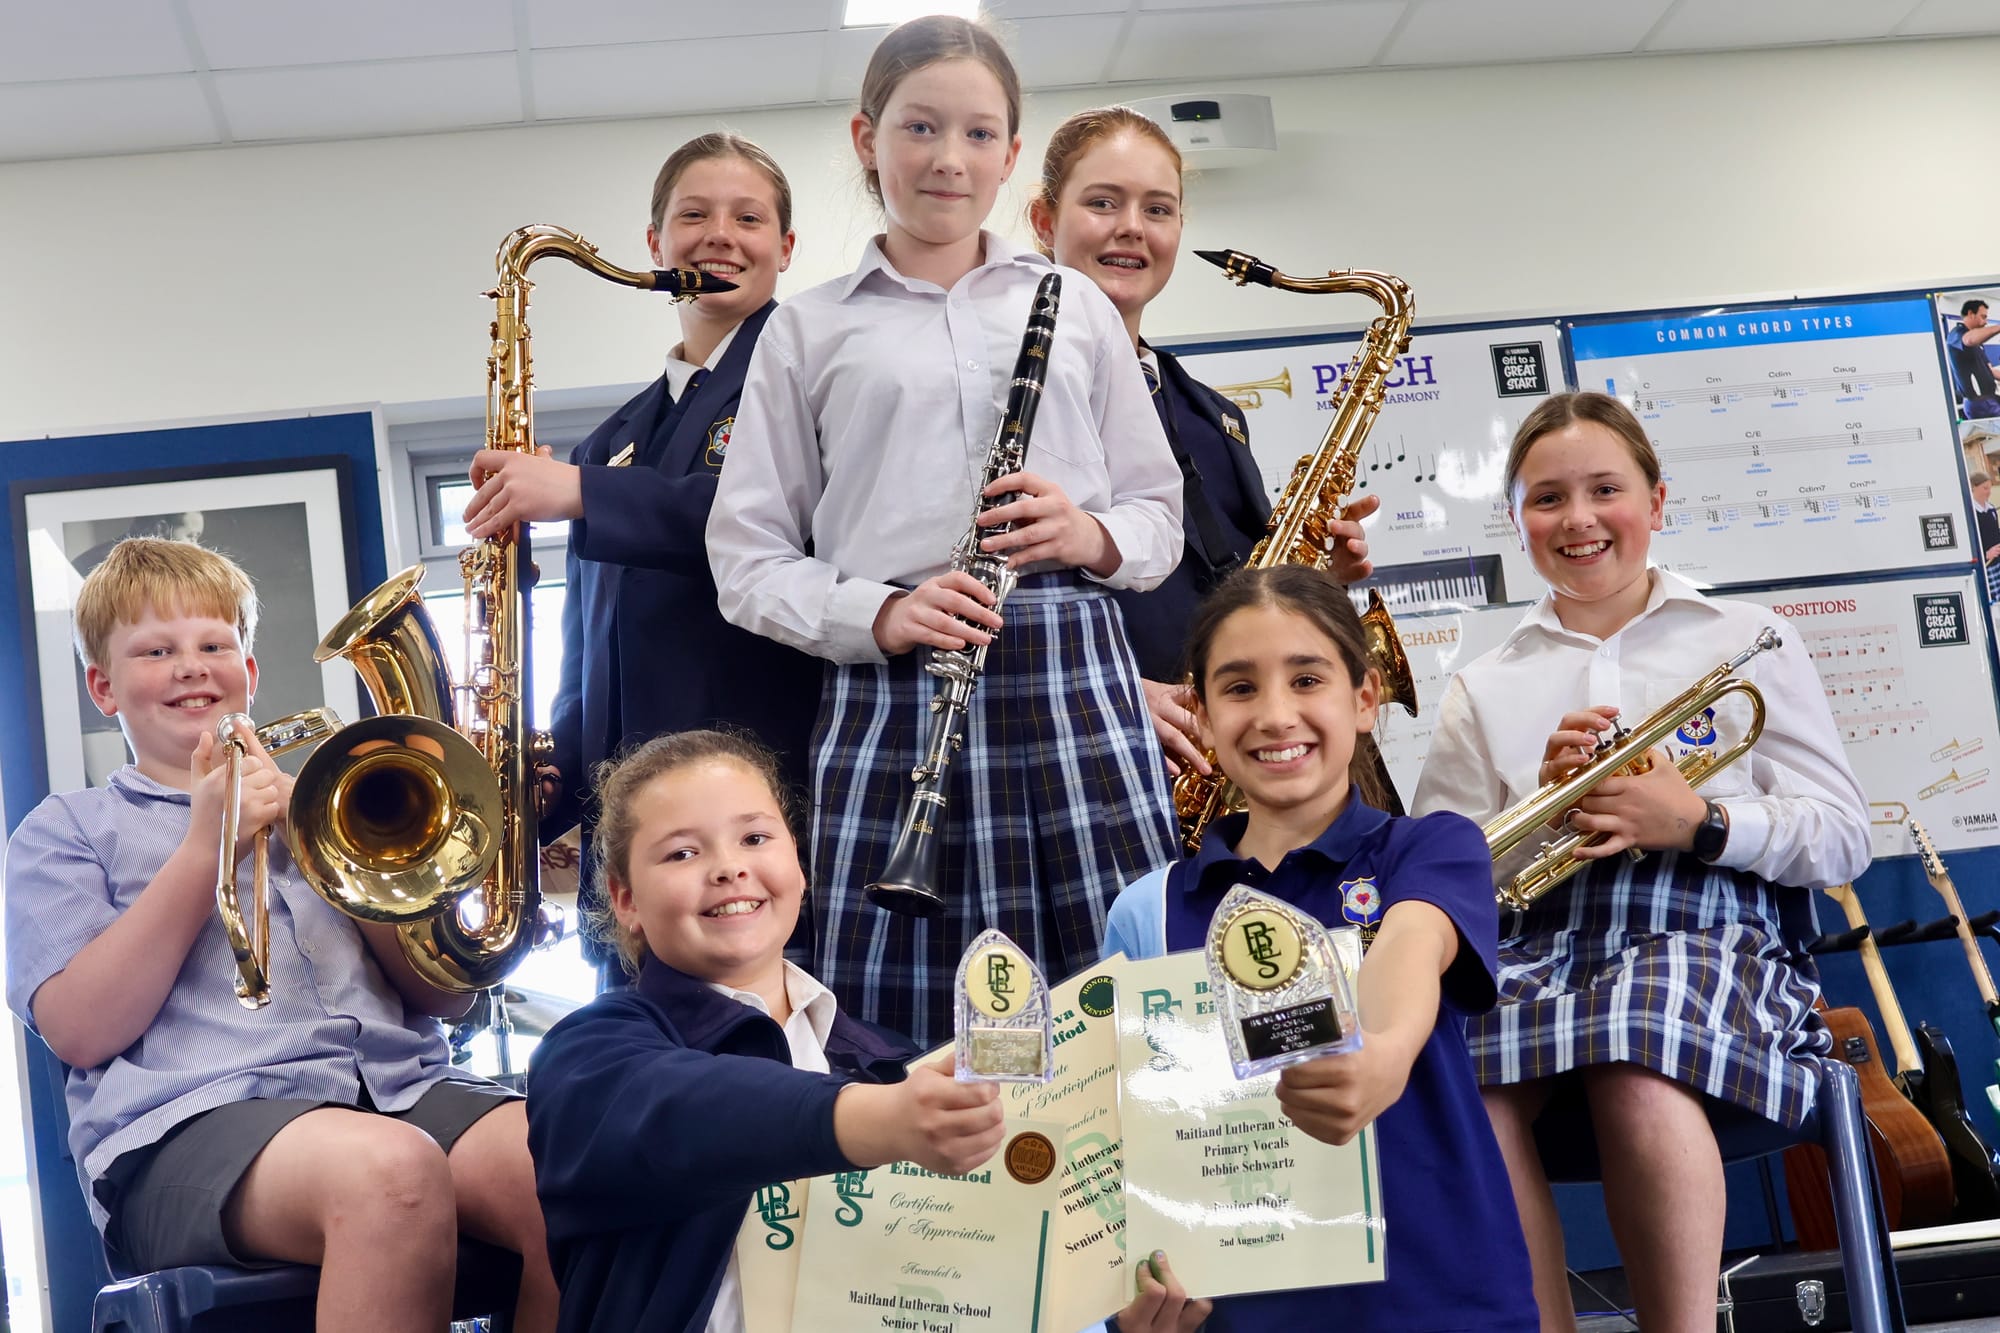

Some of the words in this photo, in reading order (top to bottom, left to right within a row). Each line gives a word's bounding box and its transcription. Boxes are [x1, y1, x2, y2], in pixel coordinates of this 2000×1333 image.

[1657, 325, 1727, 343] COMMON
[1738, 320, 1792, 336] CHORD
[1802, 315, 1853, 330] TYPES
[1502, 355, 1517, 365] Off
[1518, 355, 1528, 364] to
[1504, 363, 1536, 378] GREAT
[1506, 376, 1538, 390] START
[1773, 599, 1857, 618] POSITIONS
[1924, 606, 1938, 616] Off
[1939, 606, 1949, 614] to
[1949, 606, 1956, 614] a
[1926, 614, 1956, 628] GREAT
[1401, 628, 1458, 648] CHART
[1928, 626, 1957, 640] START
[1963, 812, 1998, 825] YAMAHA
[1083, 1002, 1115, 1016] MENTIO
[1034, 1063, 1116, 1111] Participation
[1066, 1106, 1099, 1133] warded
[1099, 1107, 1108, 1117] to
[1175, 1124, 1222, 1142] Maitland
[1225, 1120, 1275, 1136] Lutheran
[1204, 1144, 1249, 1157] Primary
[1253, 1137, 1289, 1151] Vocals
[1071, 1143, 1120, 1172] Lutheran
[1201, 1162, 1240, 1177] Debbie
[1242, 1157, 1295, 1173] Schwartz
[889, 1191, 955, 1216] Certificate
[1063, 1192, 1101, 1215] Debbie
[1256, 1195, 1289, 1210] Choir
[884, 1216, 907, 1237] of
[908, 1218, 996, 1242] Appreciation
[1064, 1229, 1104, 1255] Senior
[1219, 1237, 1235, 1247] 2nd
[1236, 1235, 1264, 1247] August
[1265, 1233, 1285, 1243] 2024
[900, 1260, 952, 1279] Awarded
[951, 1269, 961, 1280] to
[1108, 1255, 1124, 1269] 2nd
[848, 1290, 896, 1308] Maitland
[899, 1296, 949, 1314] Lutheran
[952, 1302, 992, 1319] School
[881, 1315, 919, 1331] Senior
[922, 1319, 953, 1333] Vocal
